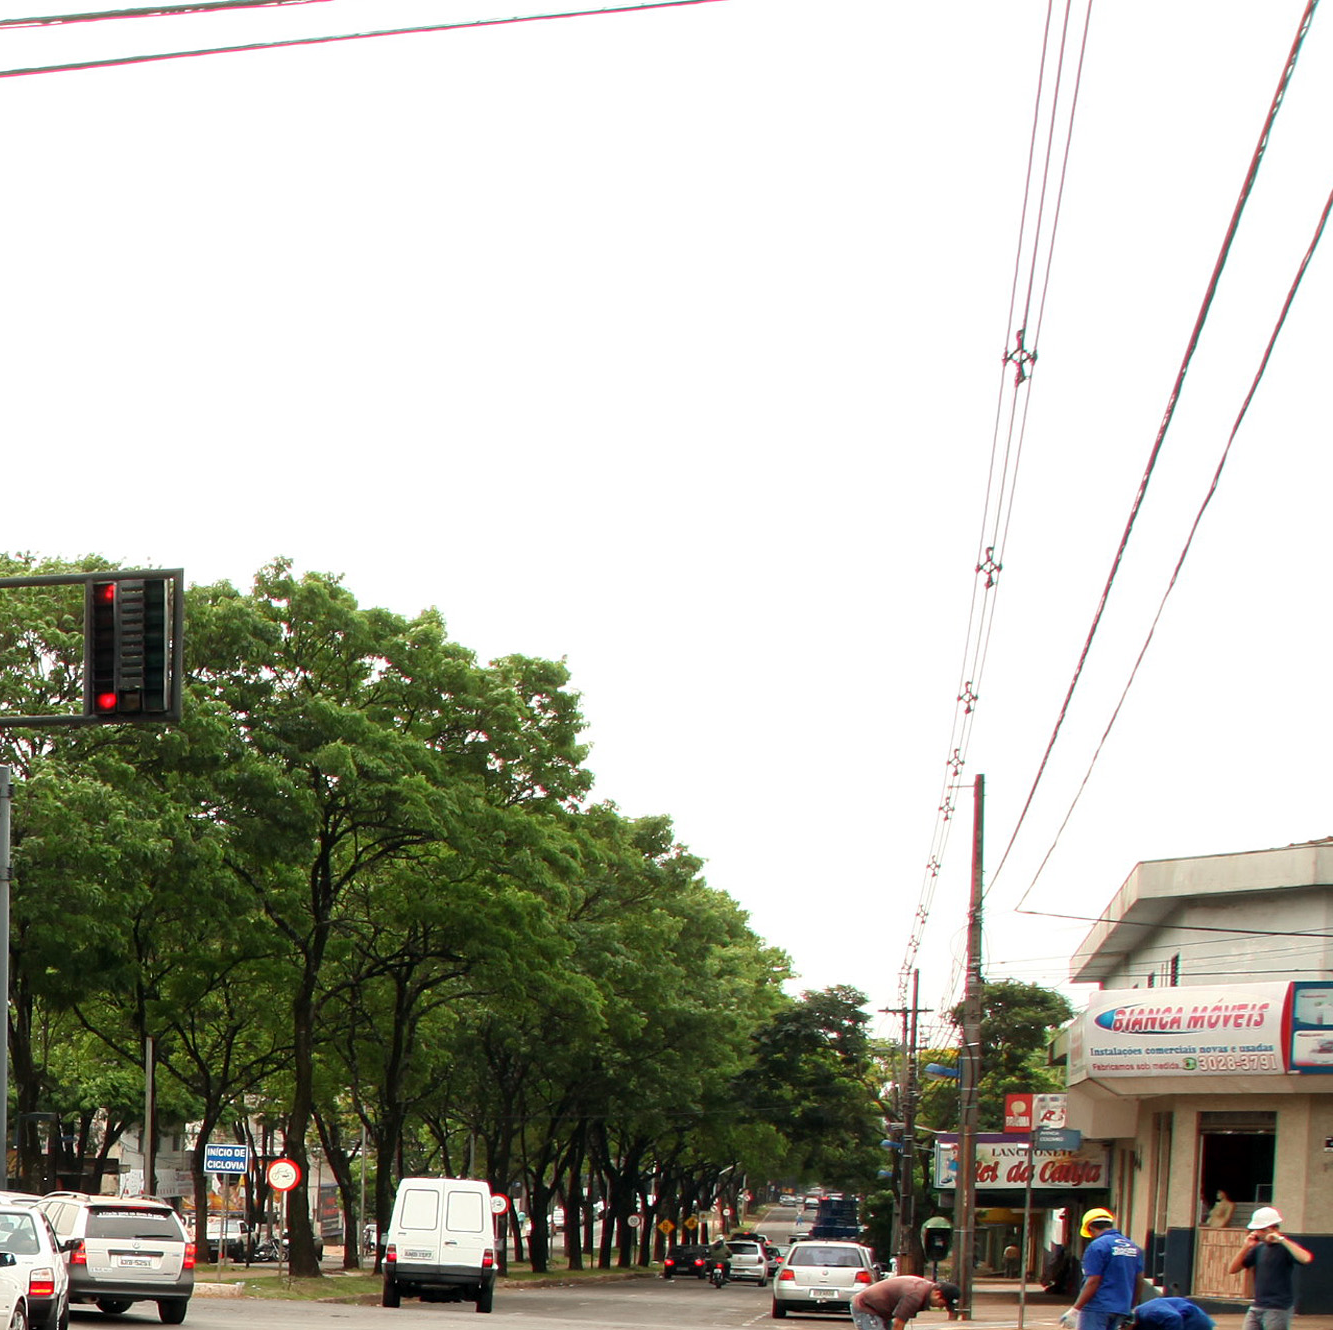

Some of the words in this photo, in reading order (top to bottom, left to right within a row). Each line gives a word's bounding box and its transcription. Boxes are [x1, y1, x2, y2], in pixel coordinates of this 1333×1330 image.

[1112, 1006, 1183, 1032] BIANCA
[1186, 998, 1270, 1030] MÓVEIS
[1090, 1046, 1142, 1058] Instalações
[1145, 1044, 1197, 1055] comerciais
[1199, 1045, 1228, 1054] novas
[1238, 1043, 1274, 1053] usadas
[1197, 1054, 1278, 1072] 3028-3791
[207, 1147, 232, 1157] INÍCIO
[234, 1148, 246, 1157] DE
[206, 1160, 245, 1170] CICLOVIA
